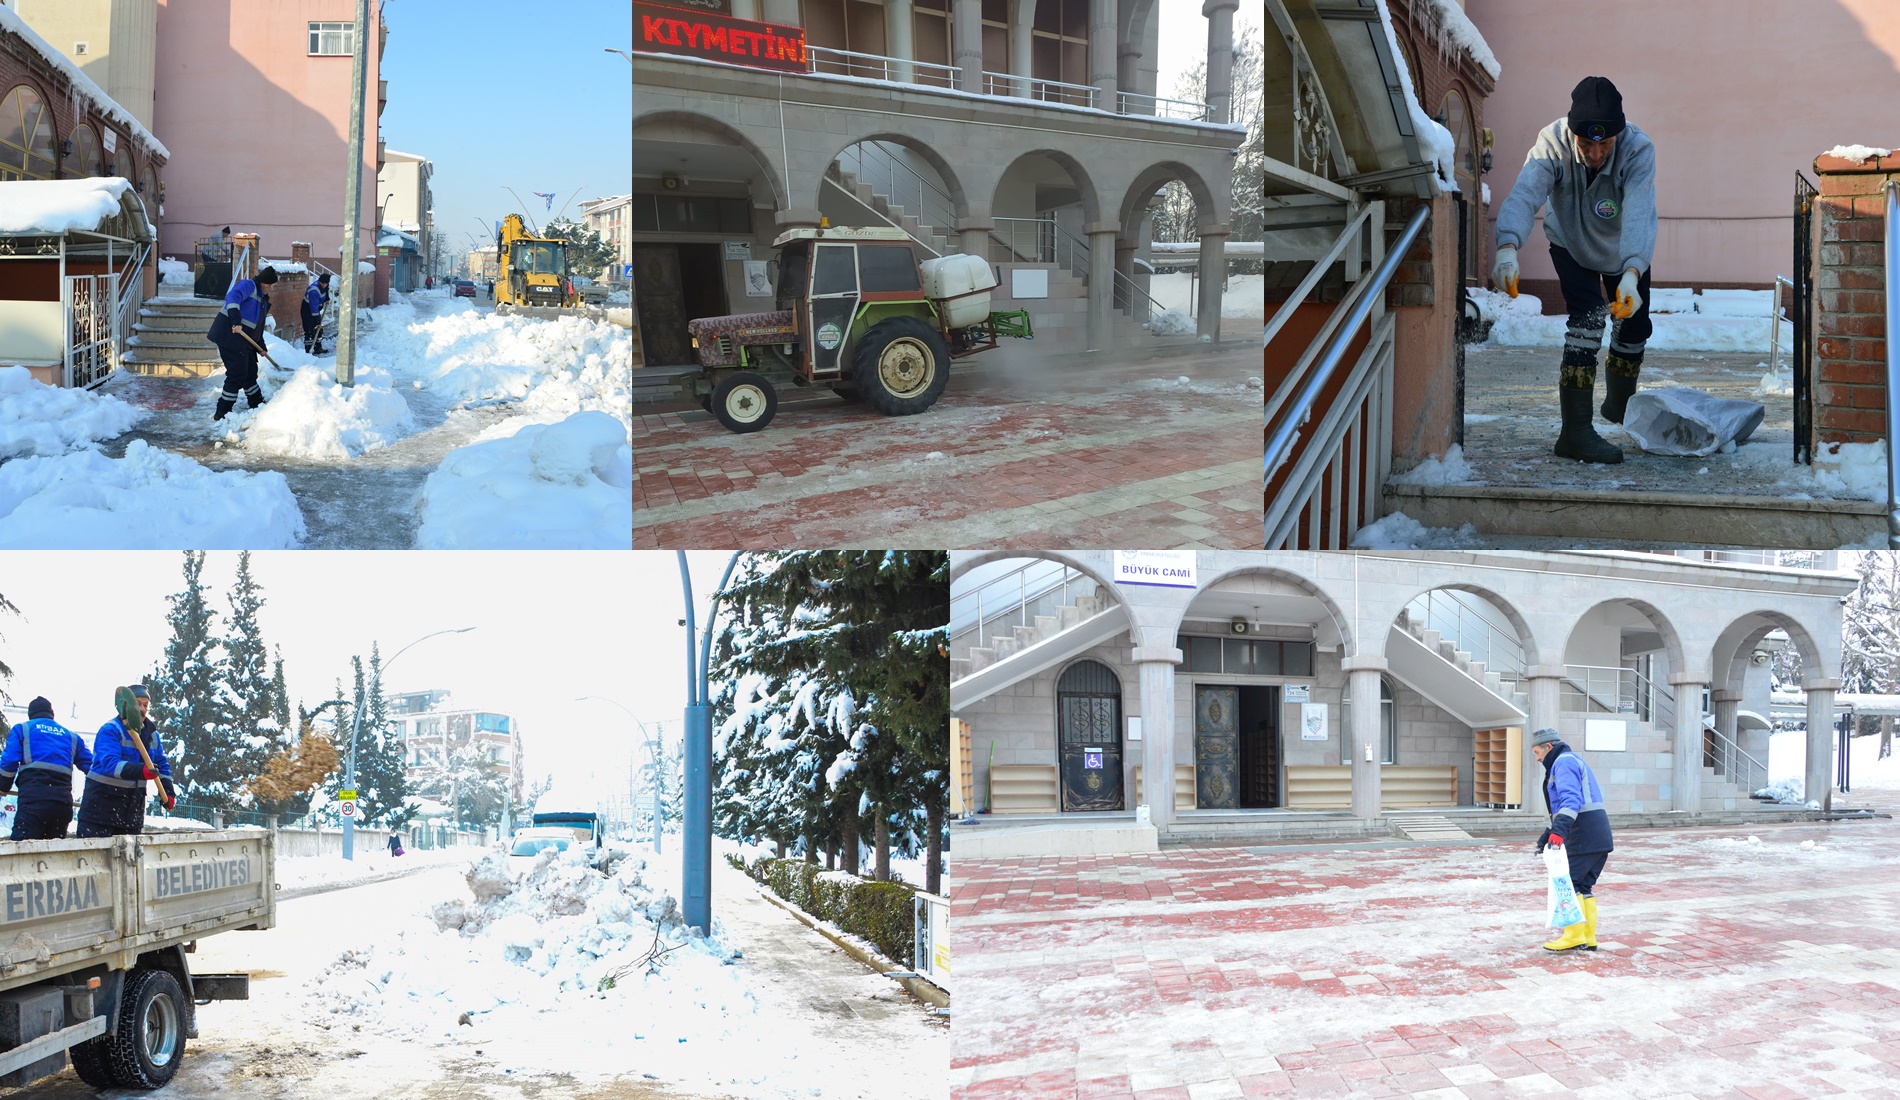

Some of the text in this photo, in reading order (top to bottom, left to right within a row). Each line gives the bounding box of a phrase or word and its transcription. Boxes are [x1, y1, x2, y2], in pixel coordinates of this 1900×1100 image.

[1122, 563, 1191, 578] BÜYÜK CAMİ
[6, 855, 250, 922] ERBAA BELEDİYESİ
